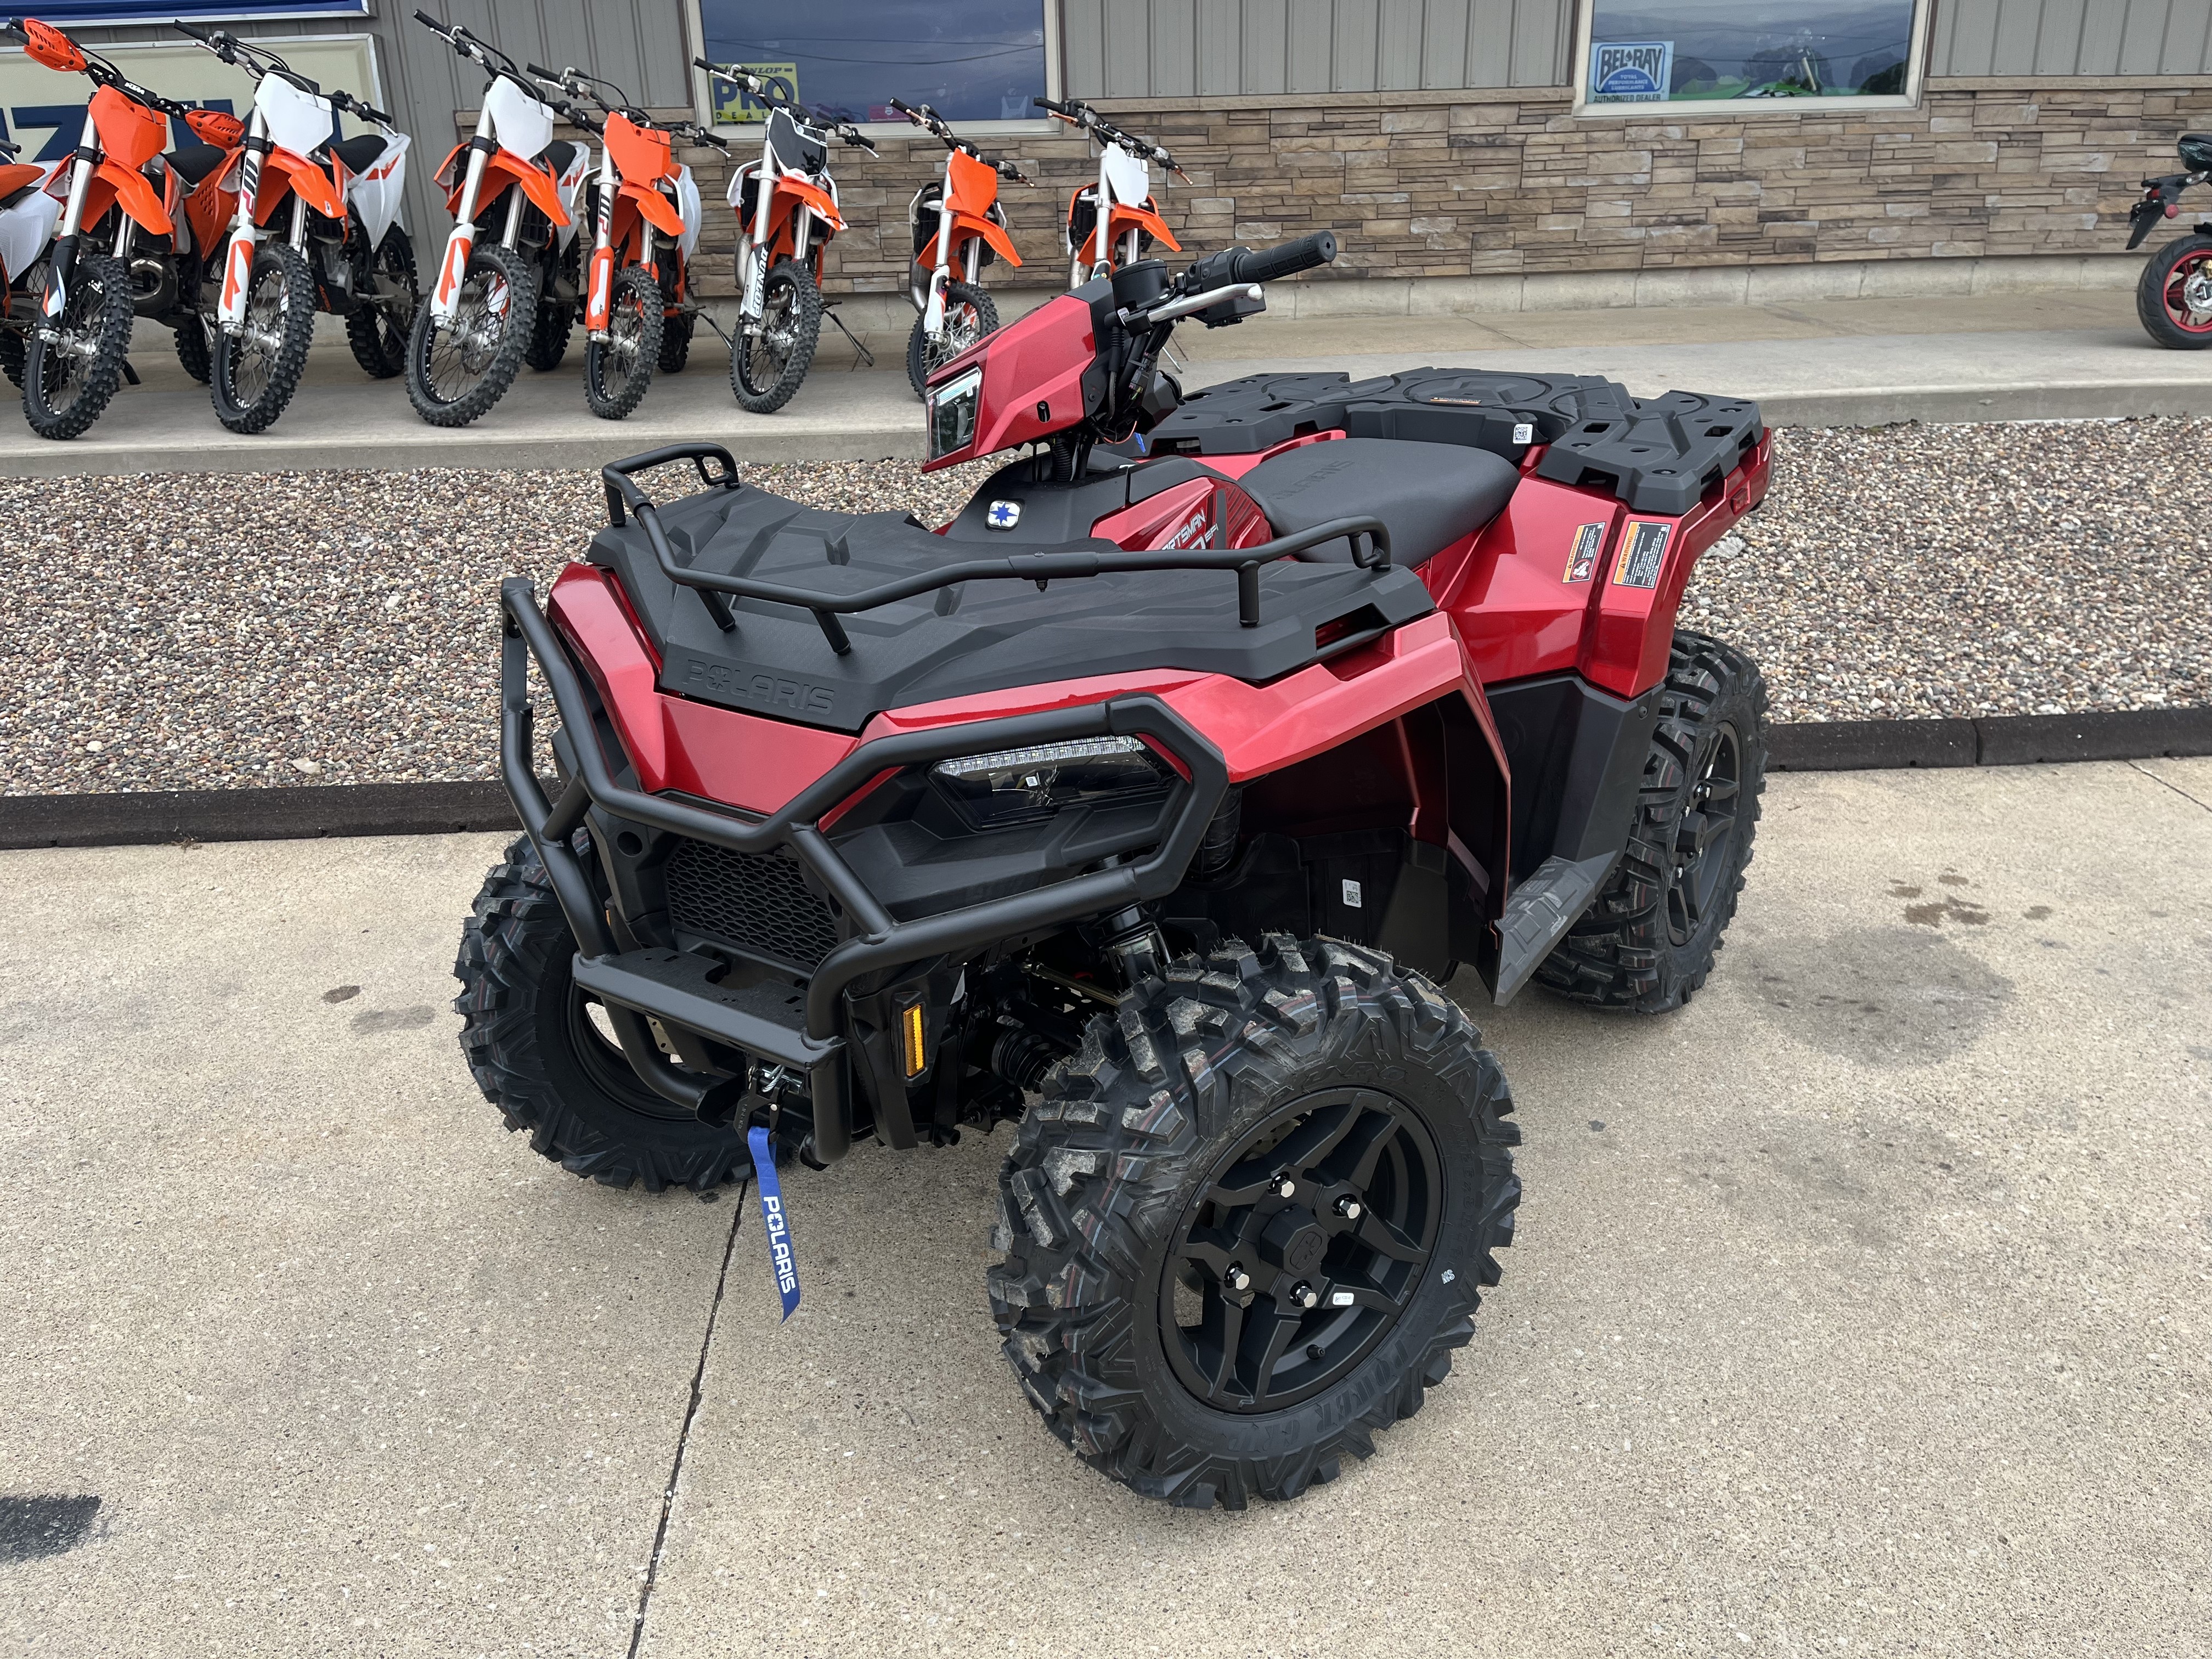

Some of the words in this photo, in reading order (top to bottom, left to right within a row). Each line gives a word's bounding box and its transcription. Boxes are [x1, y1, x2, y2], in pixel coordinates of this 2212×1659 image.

[1593, 94, 1634, 103] AUTHORIZED
[716, 111, 769, 120] DEAL
[752, 246, 769, 317] DUNLOP
[1569, 539, 1579, 563] WARNING
[1622, 535, 1633, 562] WARNING
[682, 658, 835, 715] POLARIS
[764, 1196, 796, 1294] POLARIS
